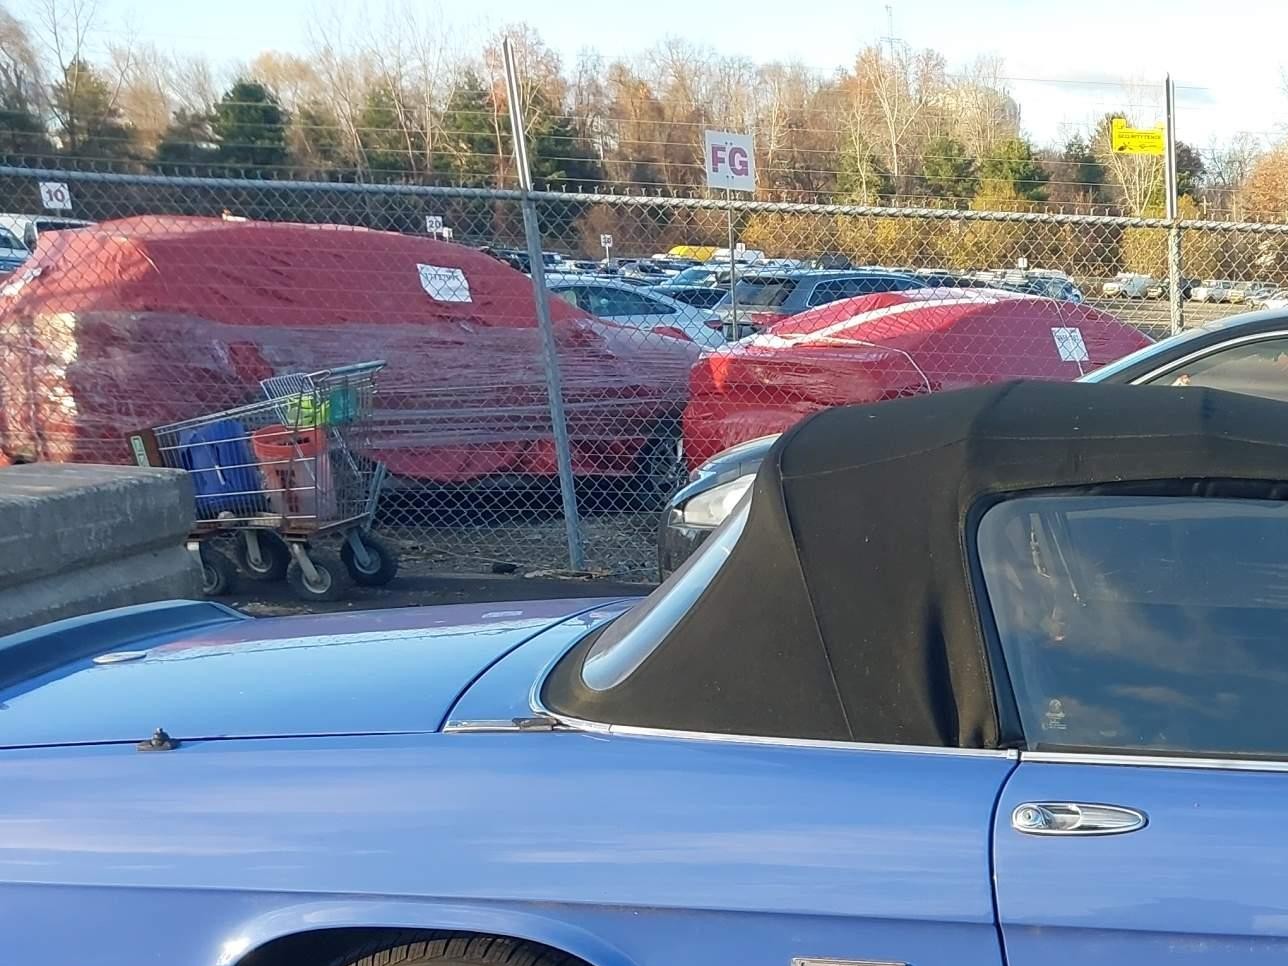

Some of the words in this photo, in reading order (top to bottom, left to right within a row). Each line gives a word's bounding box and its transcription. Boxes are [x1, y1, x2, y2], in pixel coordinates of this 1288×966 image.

[711, 144, 749, 176] FG
[46, 189, 65, 202] 10
[428, 220, 442, 230] 20
